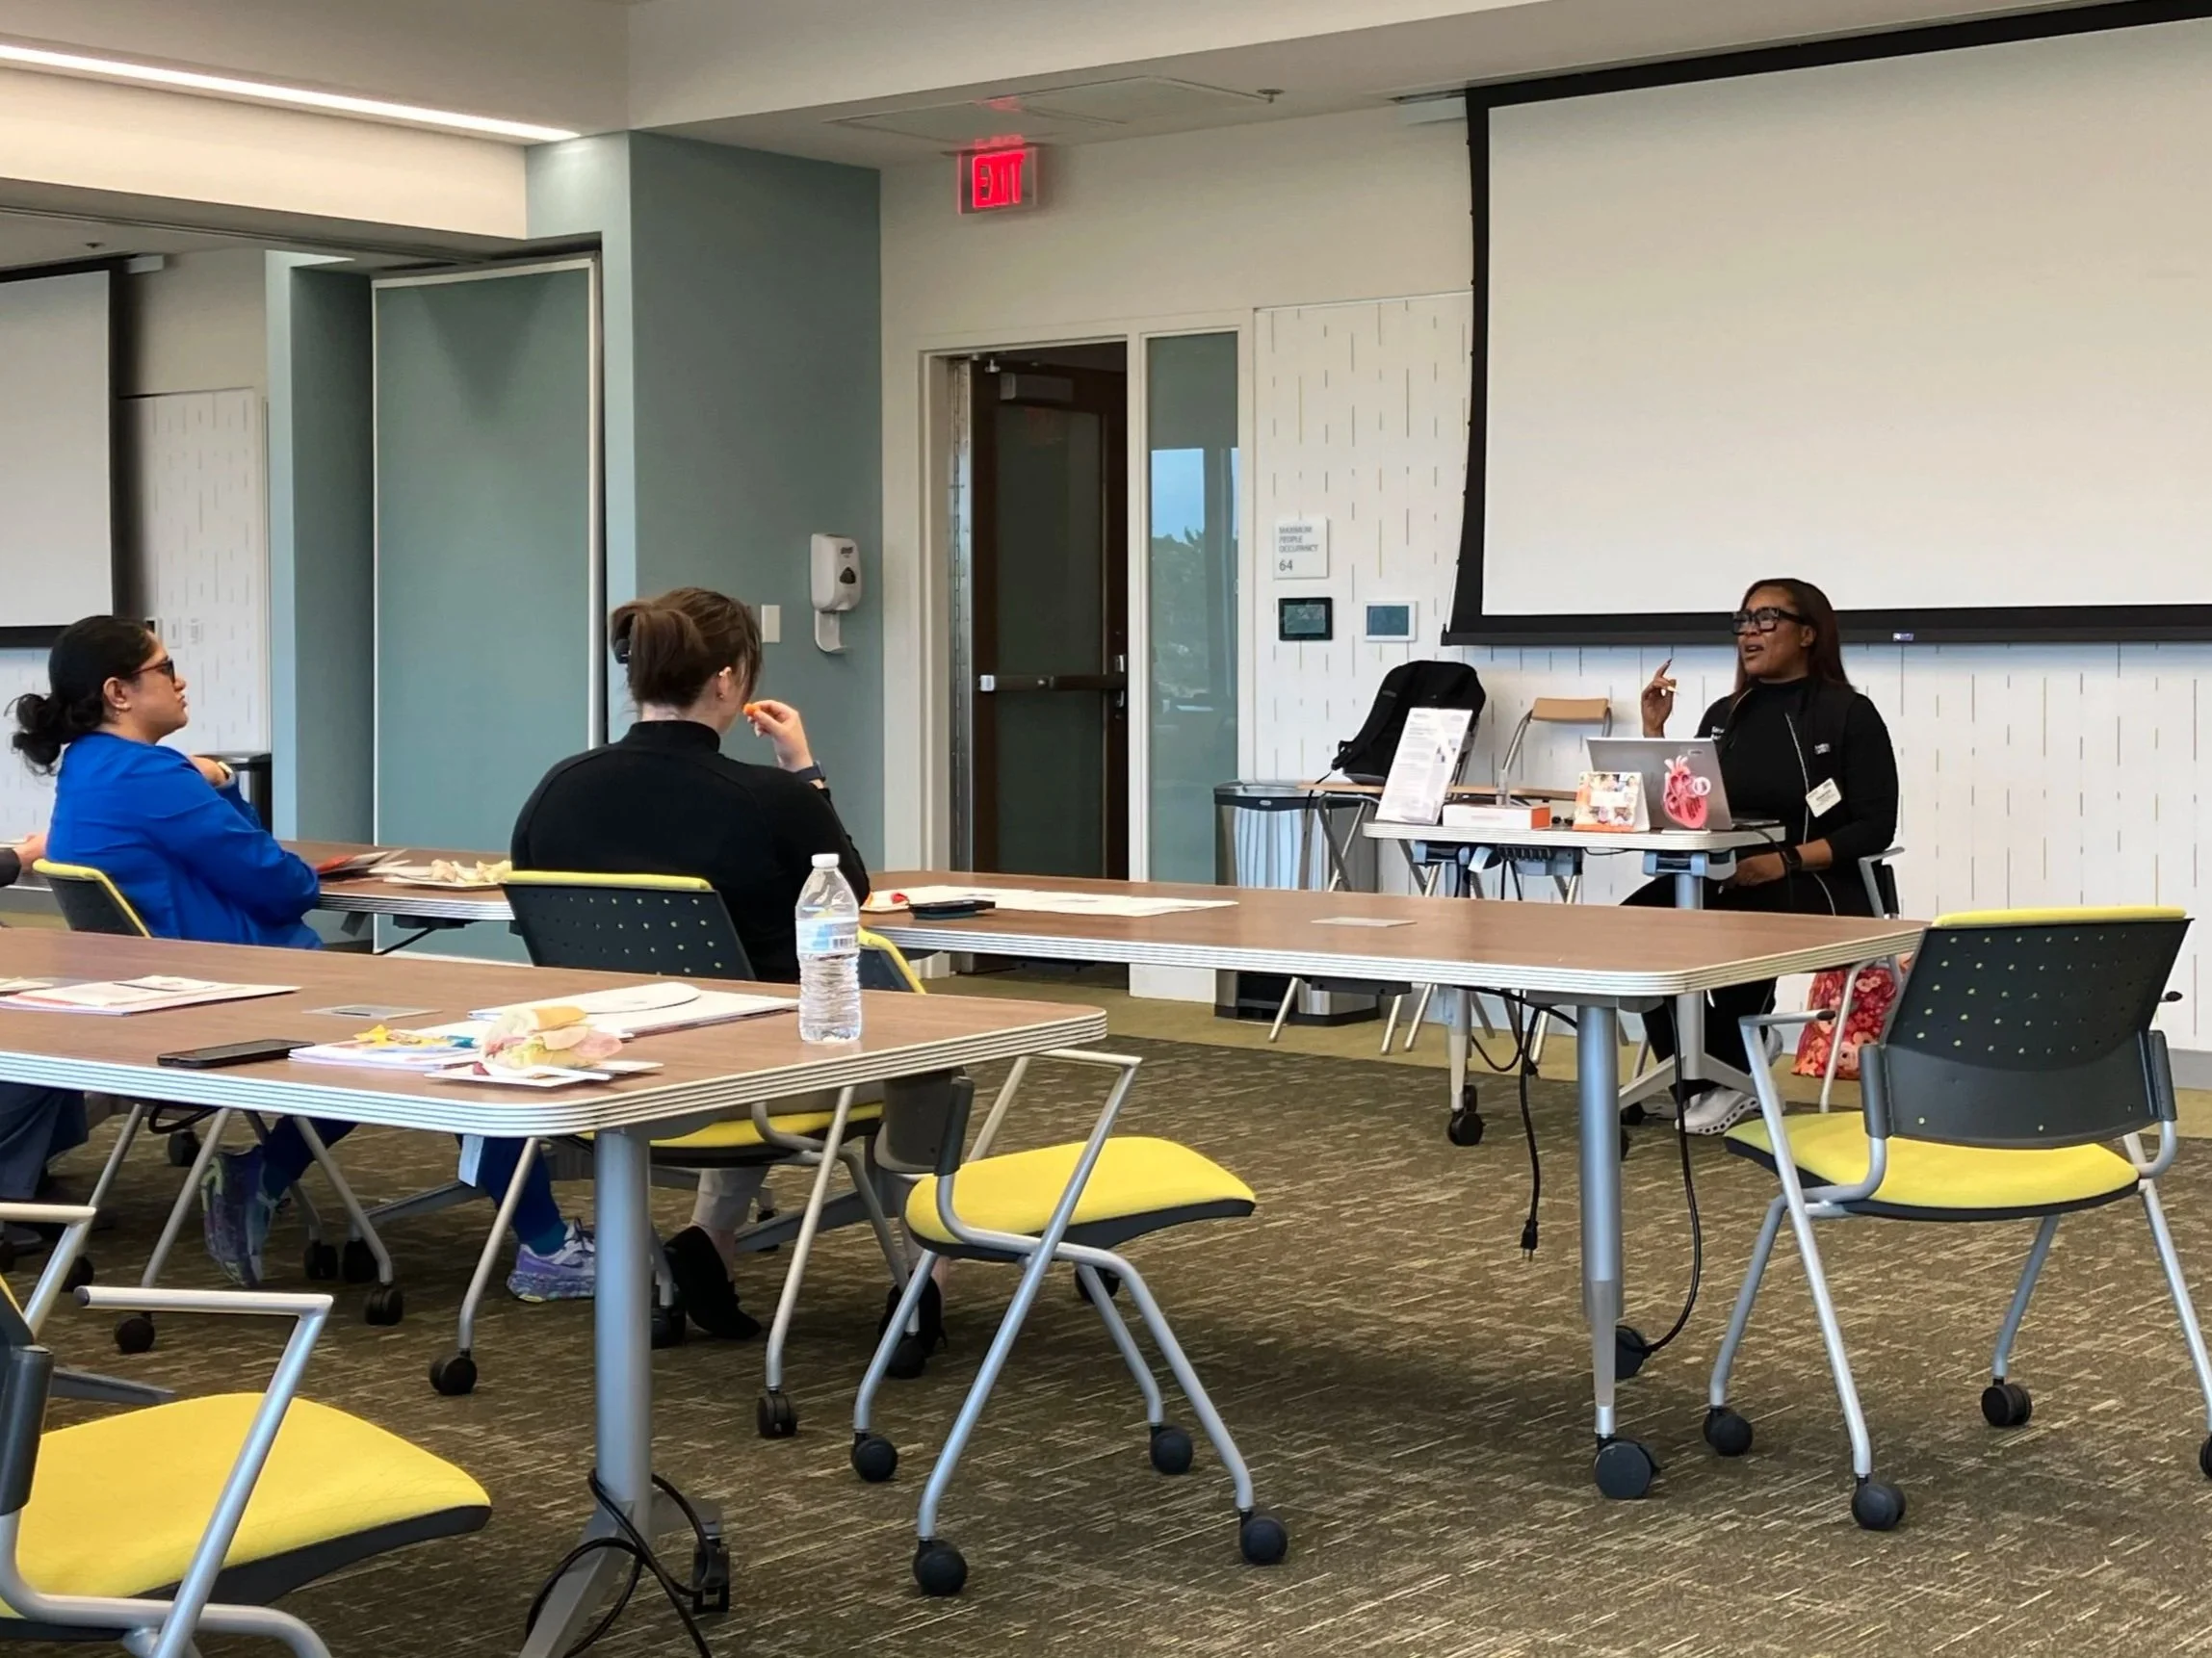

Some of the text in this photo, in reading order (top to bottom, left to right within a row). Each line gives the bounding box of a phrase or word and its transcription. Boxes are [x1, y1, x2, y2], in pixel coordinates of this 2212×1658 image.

[973, 150, 1026, 208] EXIT
[1279, 535, 1303, 544] PEOPLE
[1279, 559, 1293, 571] 64
